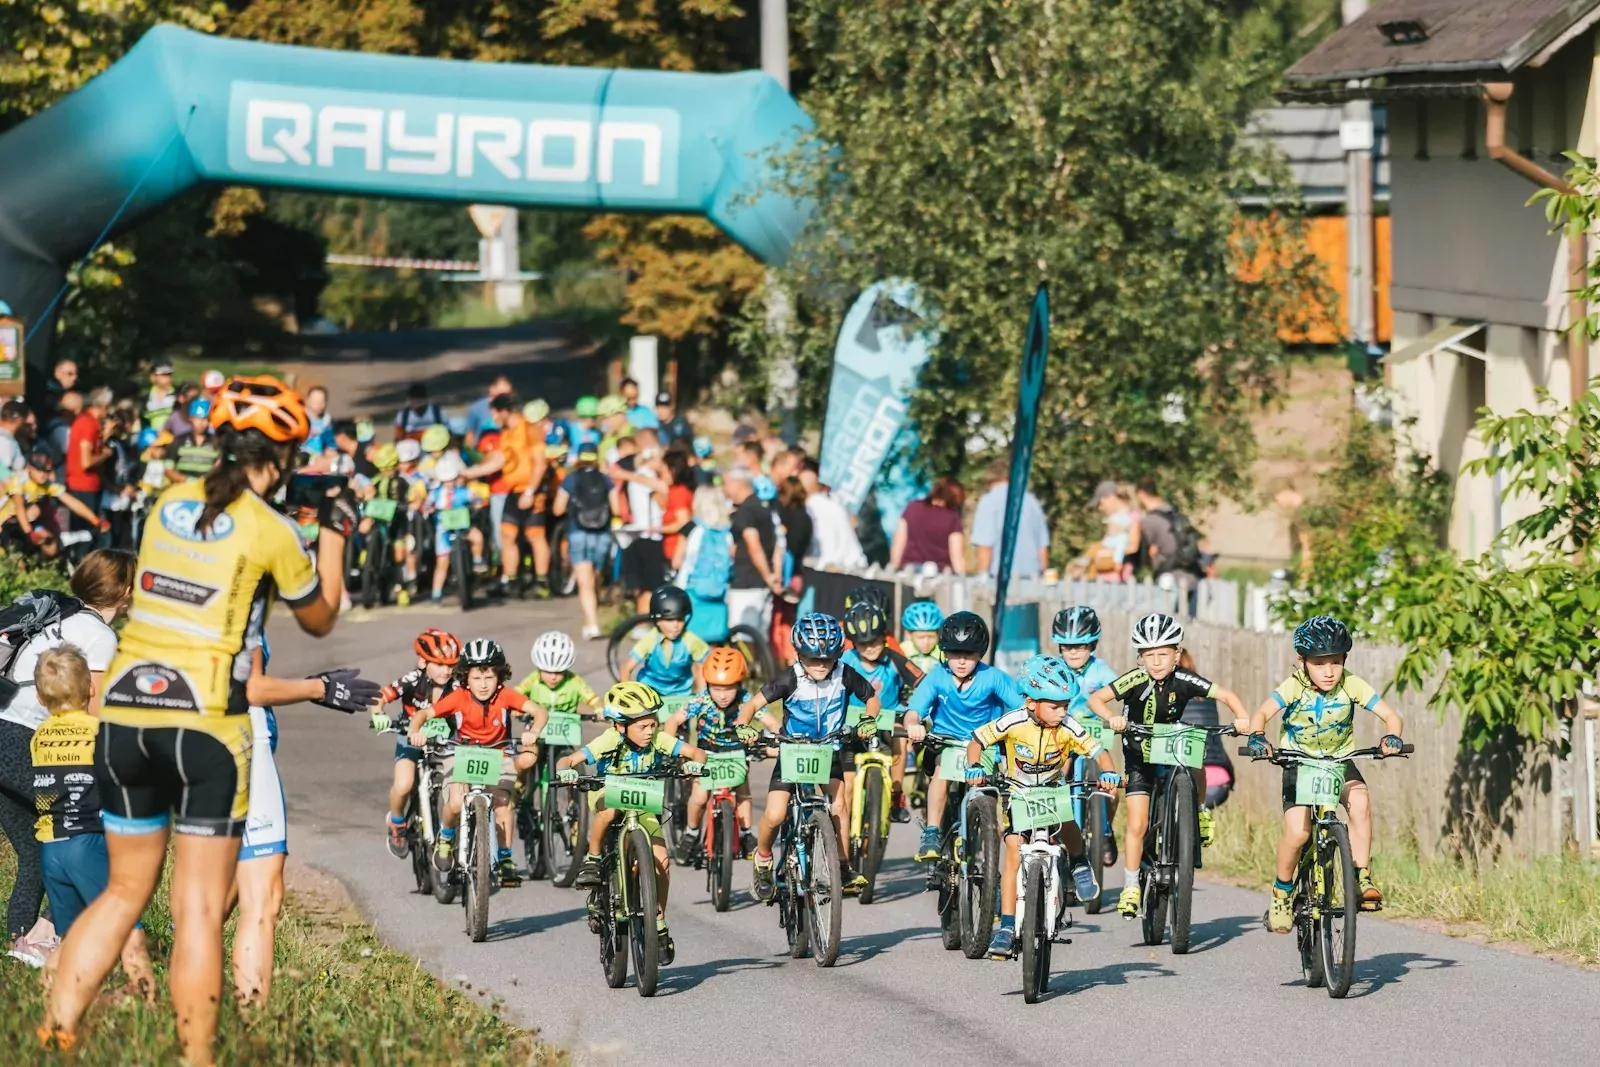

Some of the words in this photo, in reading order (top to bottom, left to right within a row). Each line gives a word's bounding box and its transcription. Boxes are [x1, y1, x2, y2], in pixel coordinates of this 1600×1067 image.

[245, 99, 663, 186] QAYRON
[332, 681, 346, 706] FOX
[546, 722, 571, 737] 602
[38, 740, 95, 748] SCOTT
[466, 759, 489, 775] 619
[710, 764, 735, 781] 606
[796, 757, 820, 775] 610
[1311, 776, 1341, 796] 608
[620, 789, 647, 806] 601
